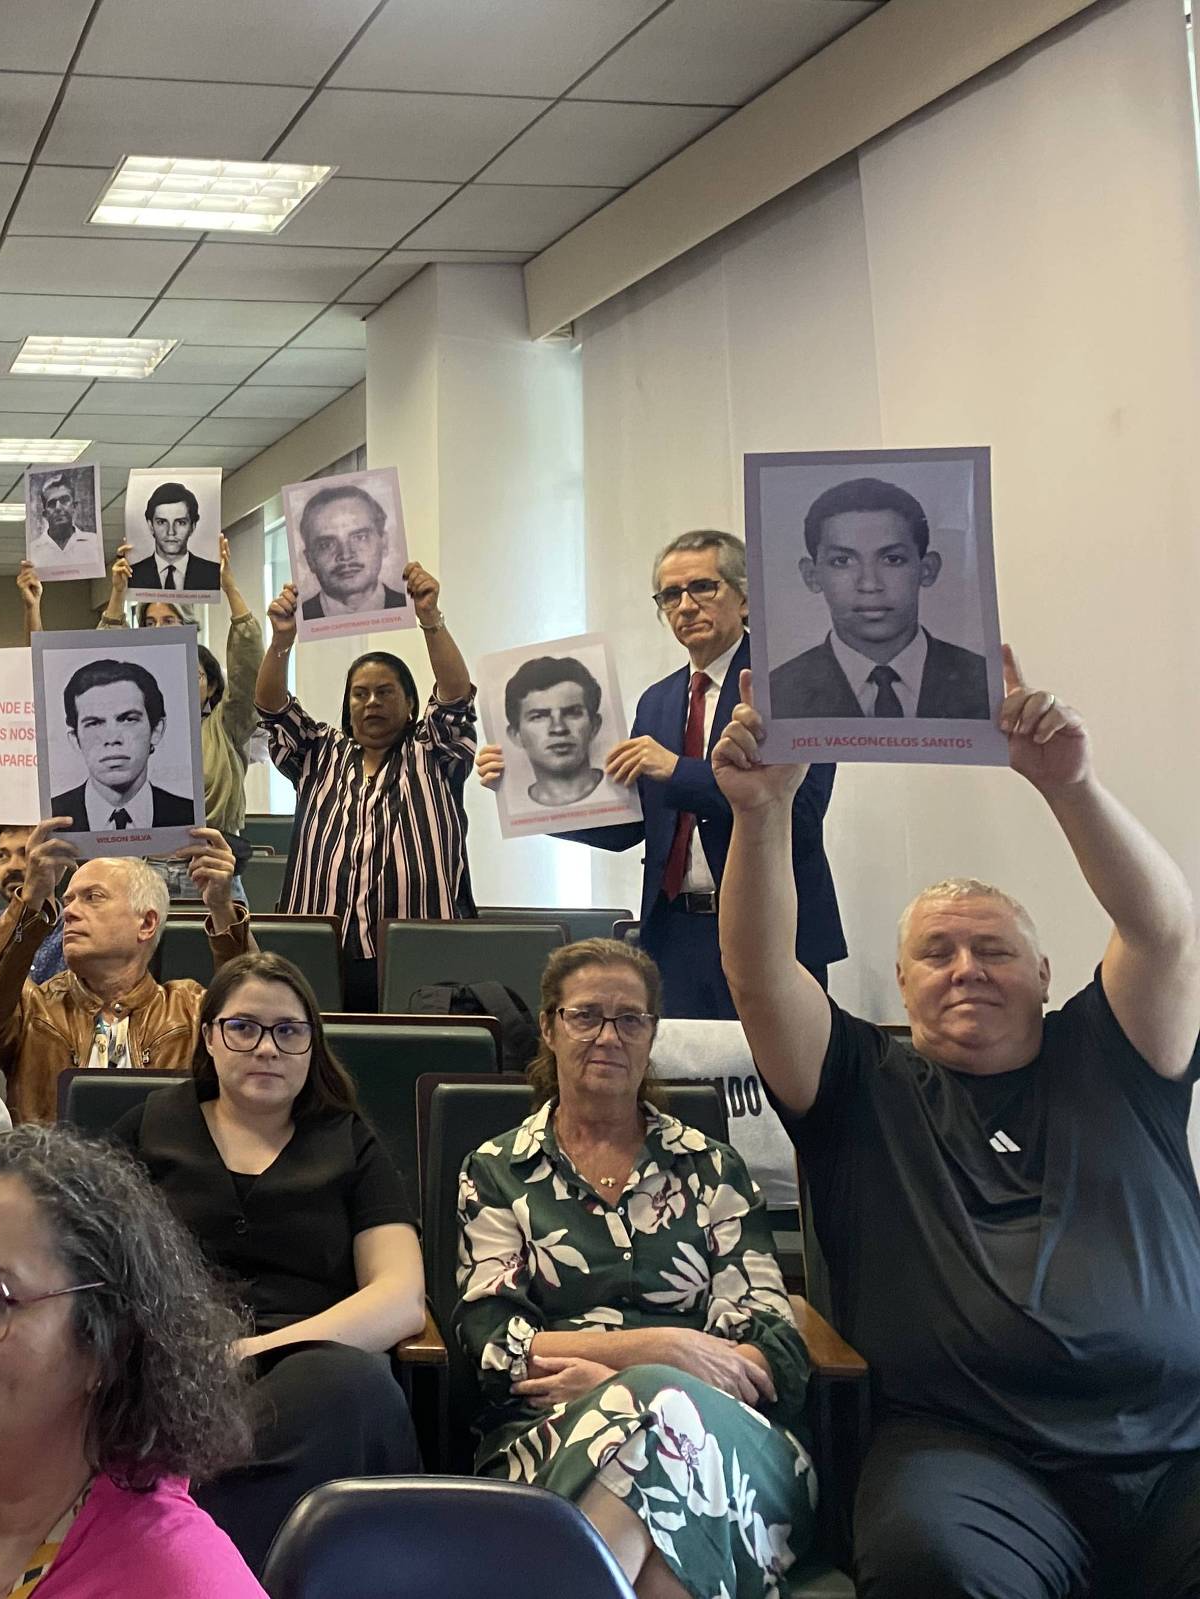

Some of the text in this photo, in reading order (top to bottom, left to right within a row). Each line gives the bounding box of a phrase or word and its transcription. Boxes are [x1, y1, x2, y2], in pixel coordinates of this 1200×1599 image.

[10, 727, 35, 740] NOS
[792, 736, 972, 749] JOEL VASCONCELOS SANTOS
[96, 835, 128, 844] WILSON
